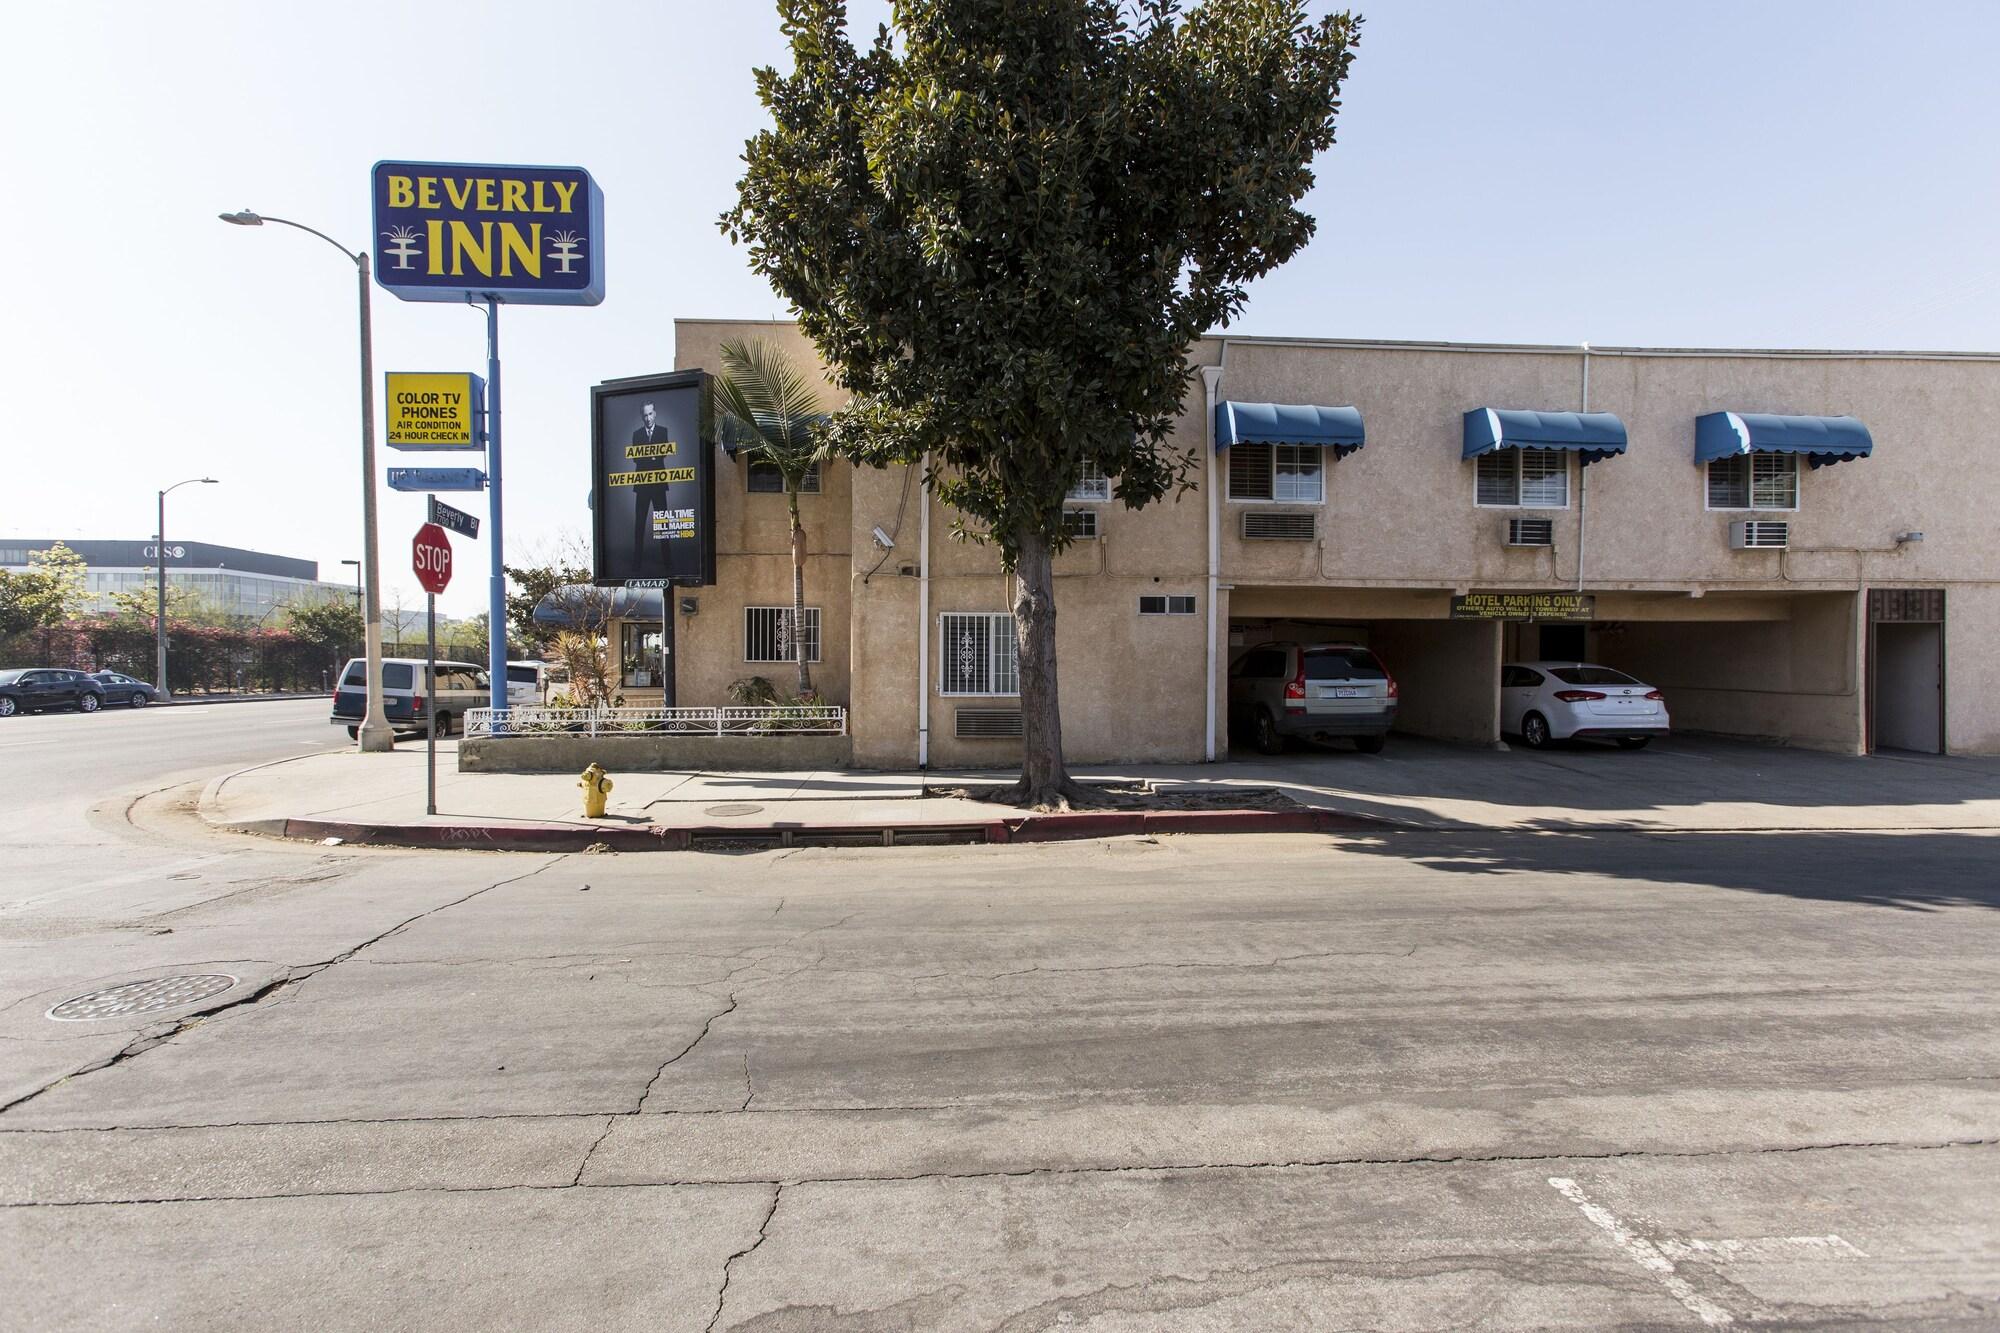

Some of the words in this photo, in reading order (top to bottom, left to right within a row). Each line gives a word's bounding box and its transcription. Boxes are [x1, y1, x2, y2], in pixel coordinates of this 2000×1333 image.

[388, 176, 578, 214] BEVERLY
[426, 220, 542, 279] INN
[397, 393, 439, 404] COLOR
[442, 393, 461, 404] TV
[401, 407, 457, 418] PHONES
[397, 421, 413, 429] AIR
[415, 421, 461, 429] CONDITION
[389, 431, 402, 439] 24
[404, 431, 429, 440] HOUR
[430, 431, 458, 440] CHECK
[461, 432, 469, 440] IN
[609, 475, 625, 485] WE
[627, 472, 652, 483] HAVE
[655, 471, 668, 481] TO
[669, 469, 694, 481] TALK
[437, 502, 464, 527] Beverly
[653, 510, 674, 519] REAL
[674, 509, 695, 518] TIME
[669, 521, 695, 530] MAHER
[681, 530, 695, 538] HBO
[416, 544, 450, 573] STOP
[629, 580, 666, 588] LAMAR
[1465, 594, 1500, 606] HOTEL
[1503, 595, 1550, 606] PARKNG
[1553, 596, 1582, 607] ONLY
